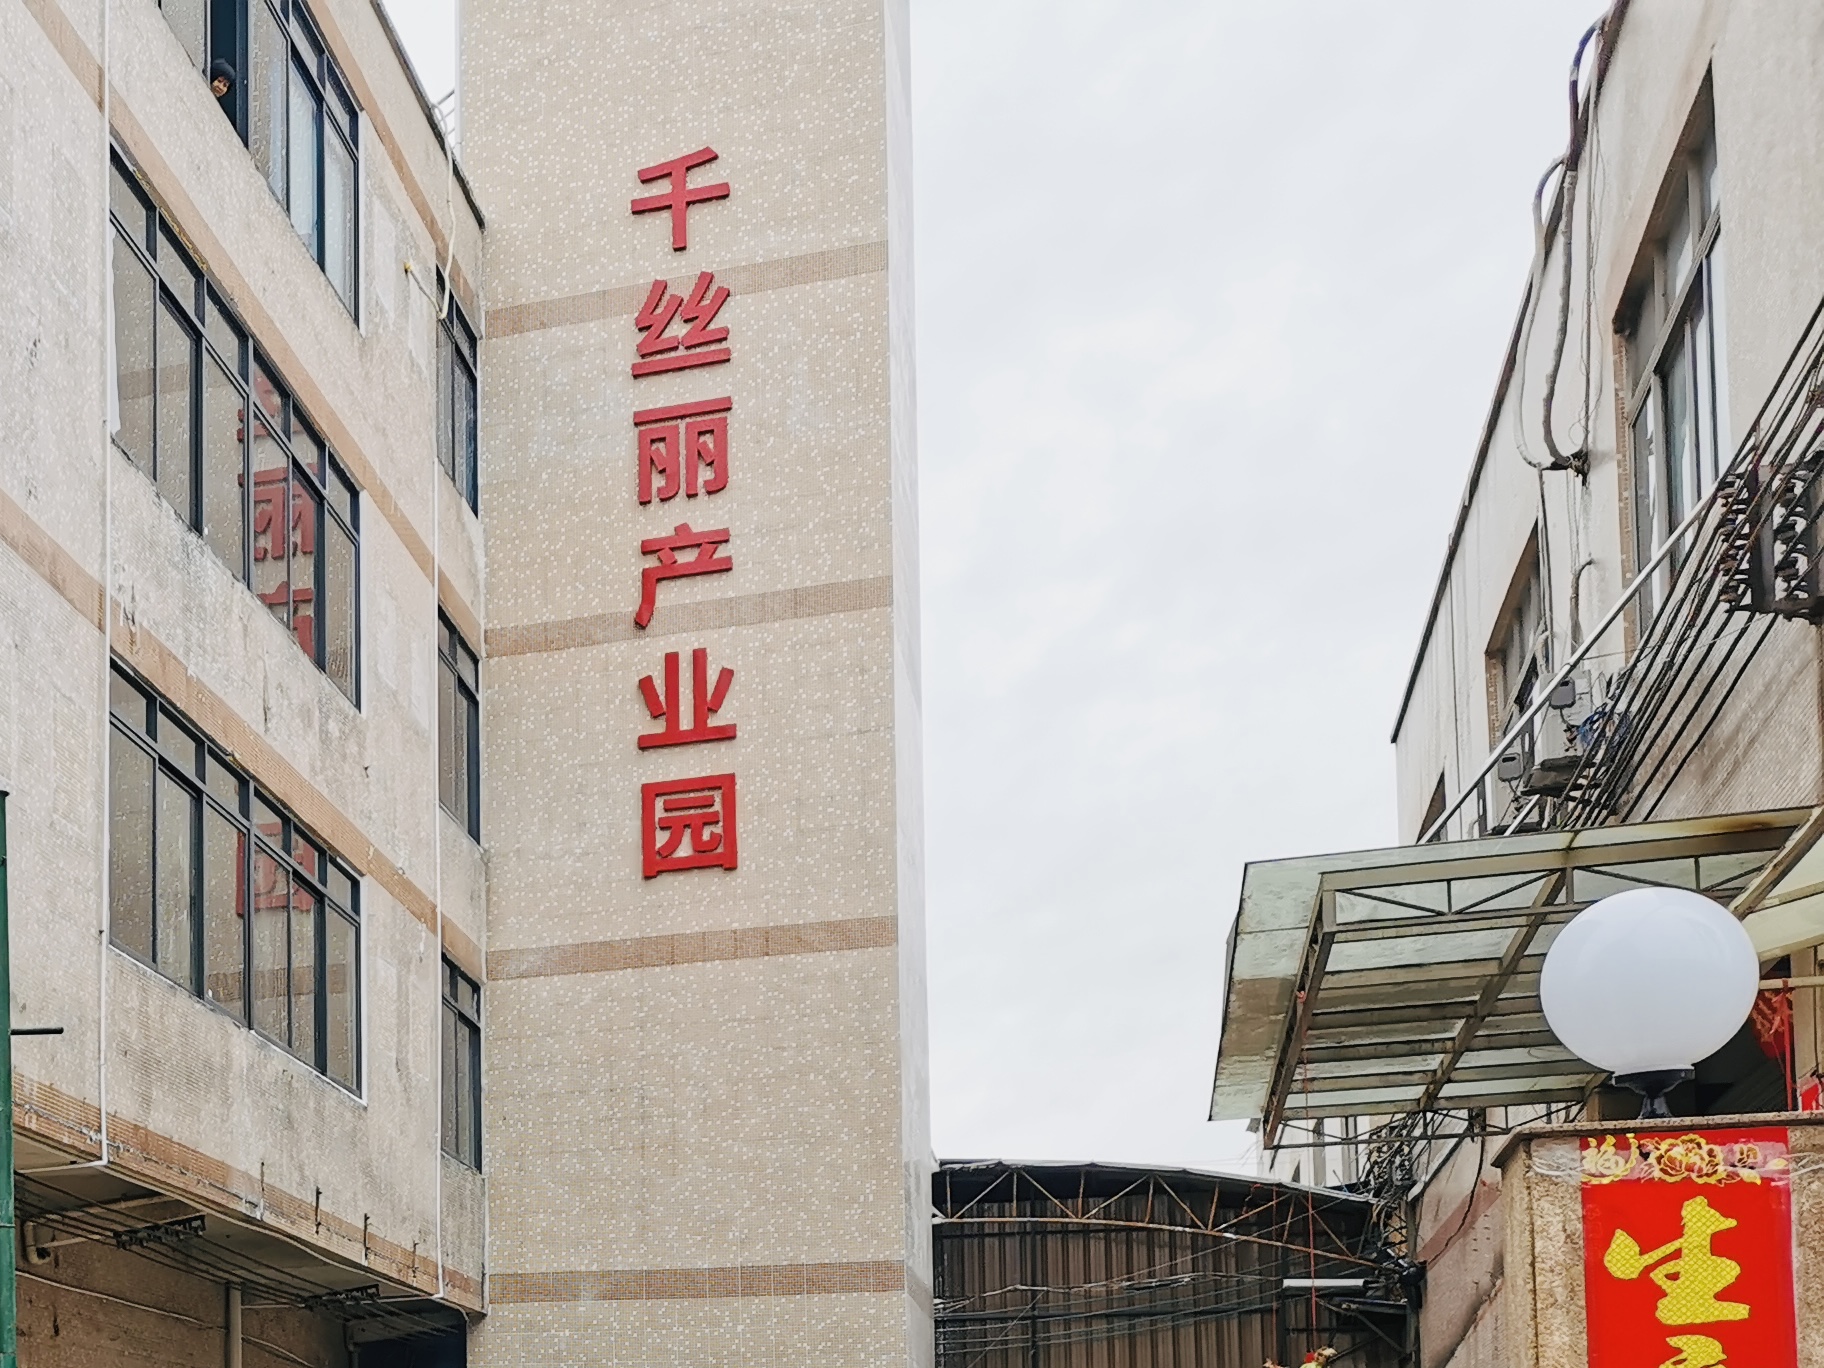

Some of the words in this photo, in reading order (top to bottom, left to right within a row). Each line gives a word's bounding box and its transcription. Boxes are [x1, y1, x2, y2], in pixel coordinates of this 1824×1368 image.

[630, 145, 739, 880] 千丝丽产业园
